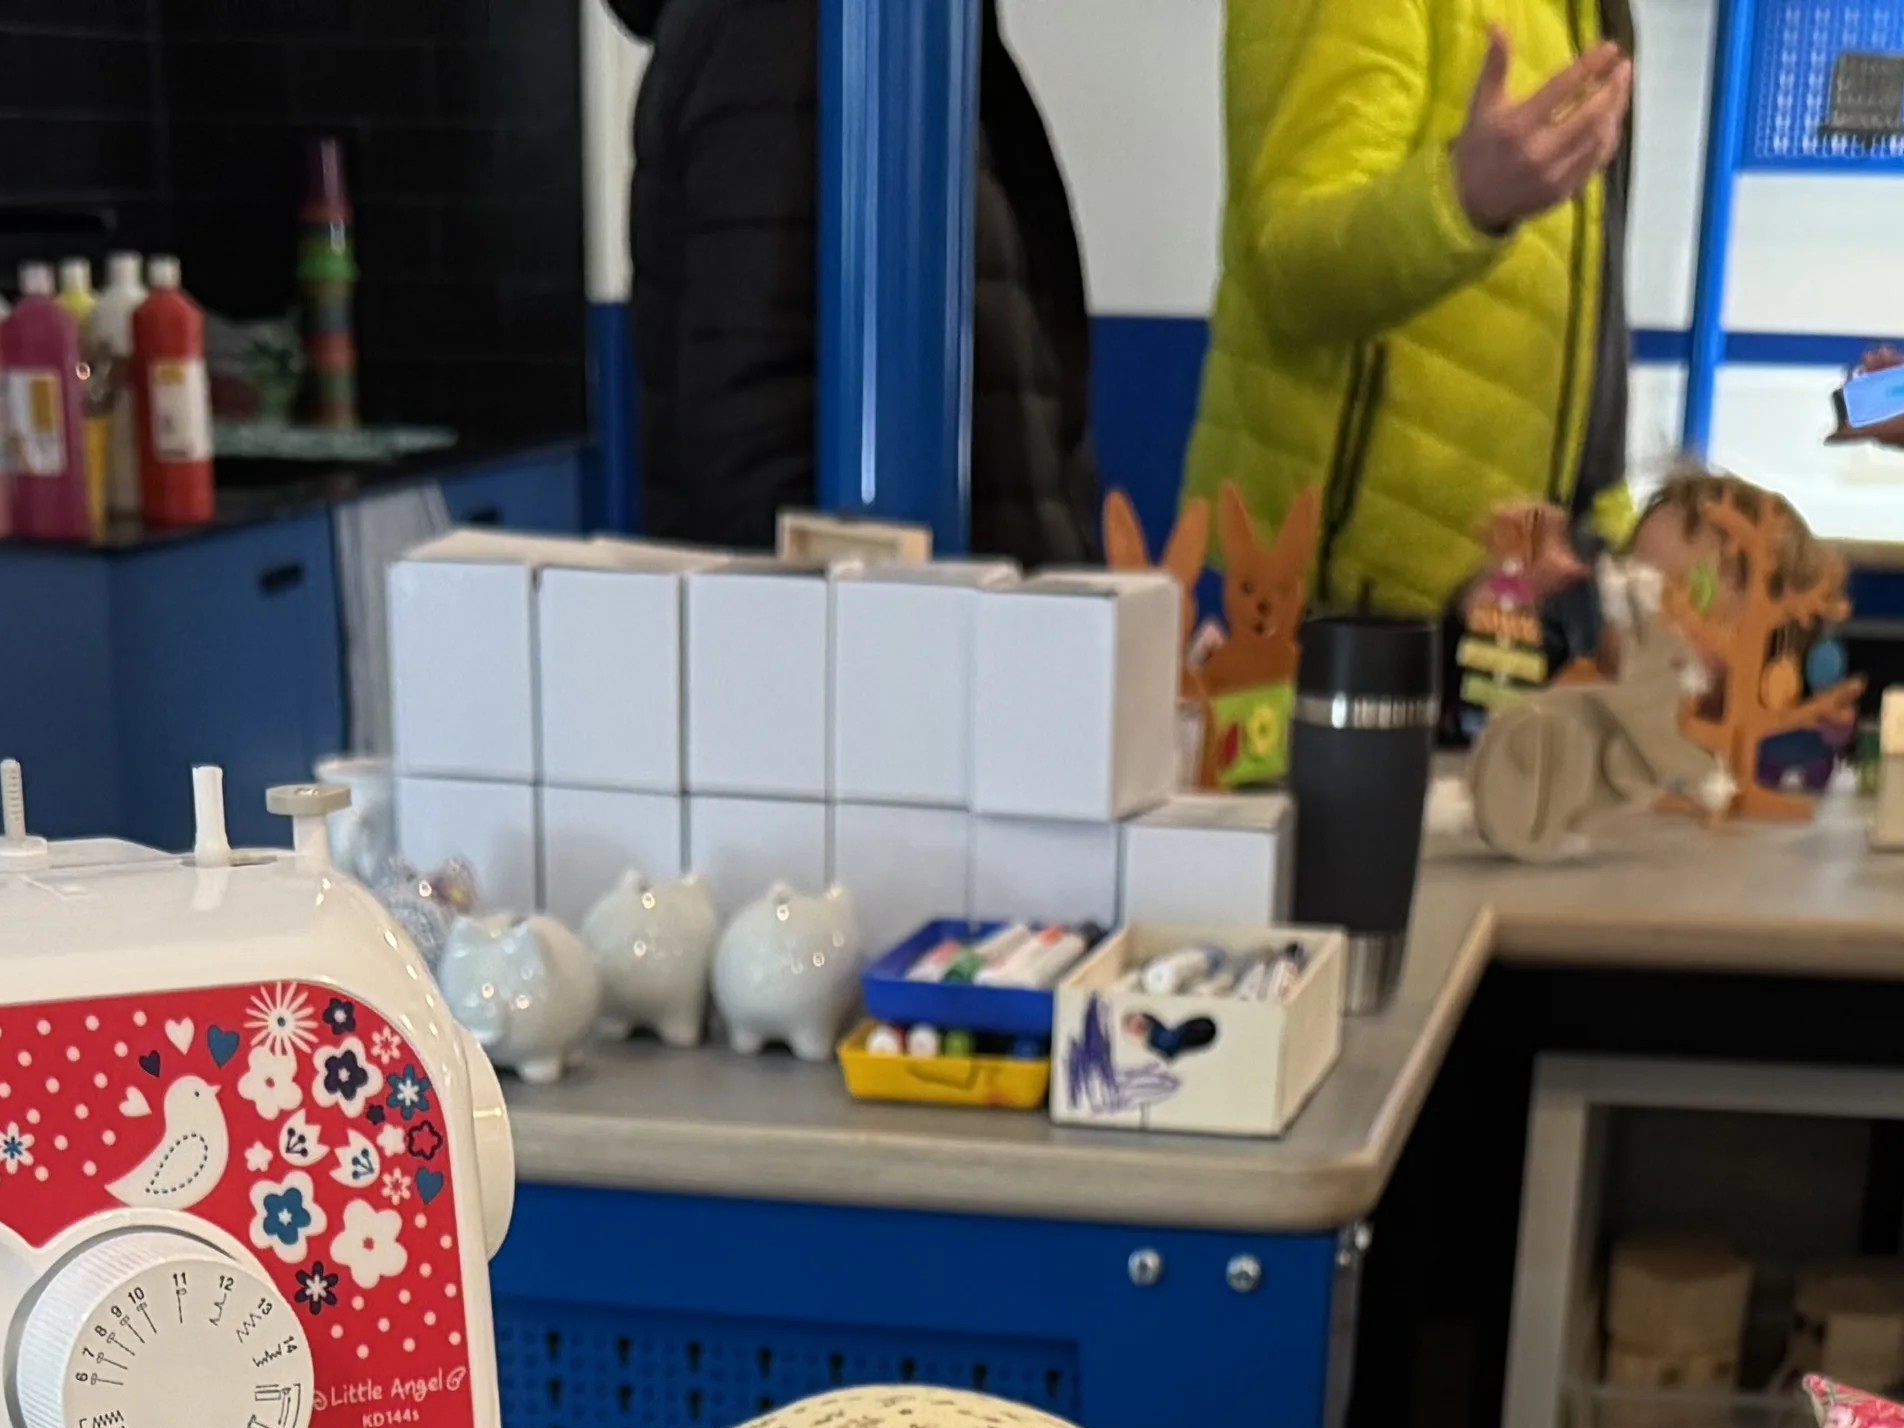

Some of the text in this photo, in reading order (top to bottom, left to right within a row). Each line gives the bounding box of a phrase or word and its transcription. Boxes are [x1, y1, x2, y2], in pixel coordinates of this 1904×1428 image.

[172, 1272, 188, 1286] 11
[218, 1275, 235, 1291] 12
[127, 1287, 146, 1304] 10
[110, 1305, 124, 1320] 9
[258, 1297, 274, 1316] 13
[94, 1325, 108, 1338] 8
[82, 1347, 95, 1358] 7
[75, 1371, 89, 1383] 6
[331, 1367, 444, 1407] Little Angel
